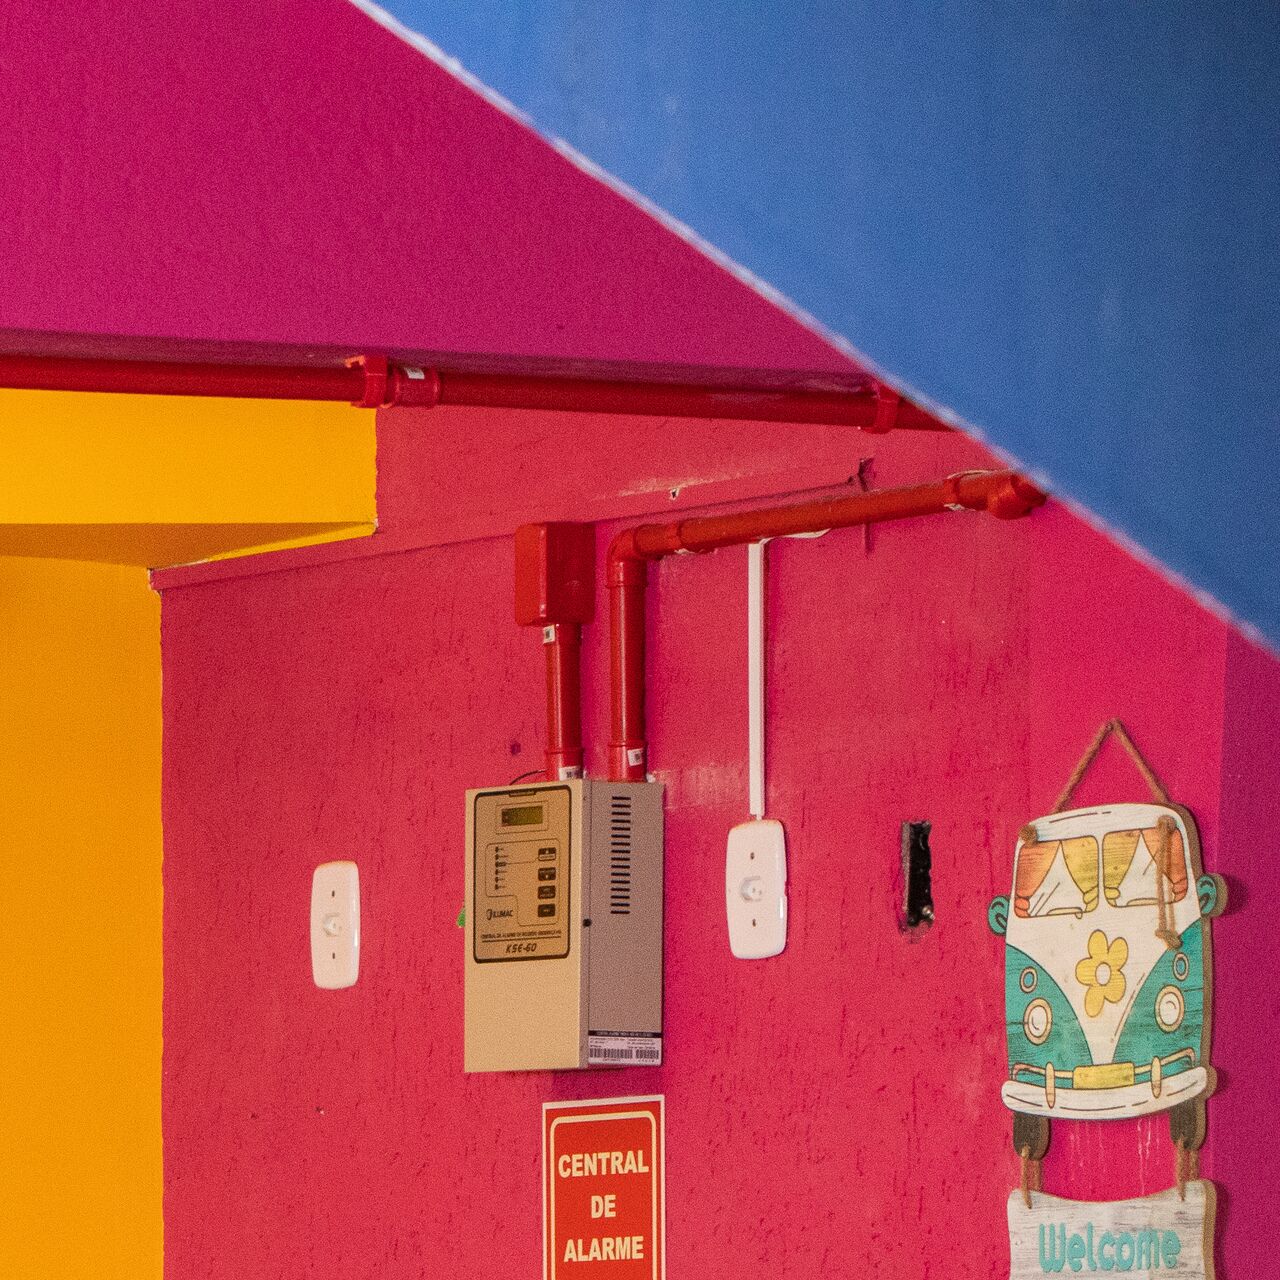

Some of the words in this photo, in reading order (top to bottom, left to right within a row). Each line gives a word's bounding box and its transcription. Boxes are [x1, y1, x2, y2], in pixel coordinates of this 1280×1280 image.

[558, 1150, 649, 1178] CENTRAL
[591, 1195, 616, 1218] DE
[564, 1236, 644, 1262] ALARME
[1039, 1221, 1181, 1273] Welcome
